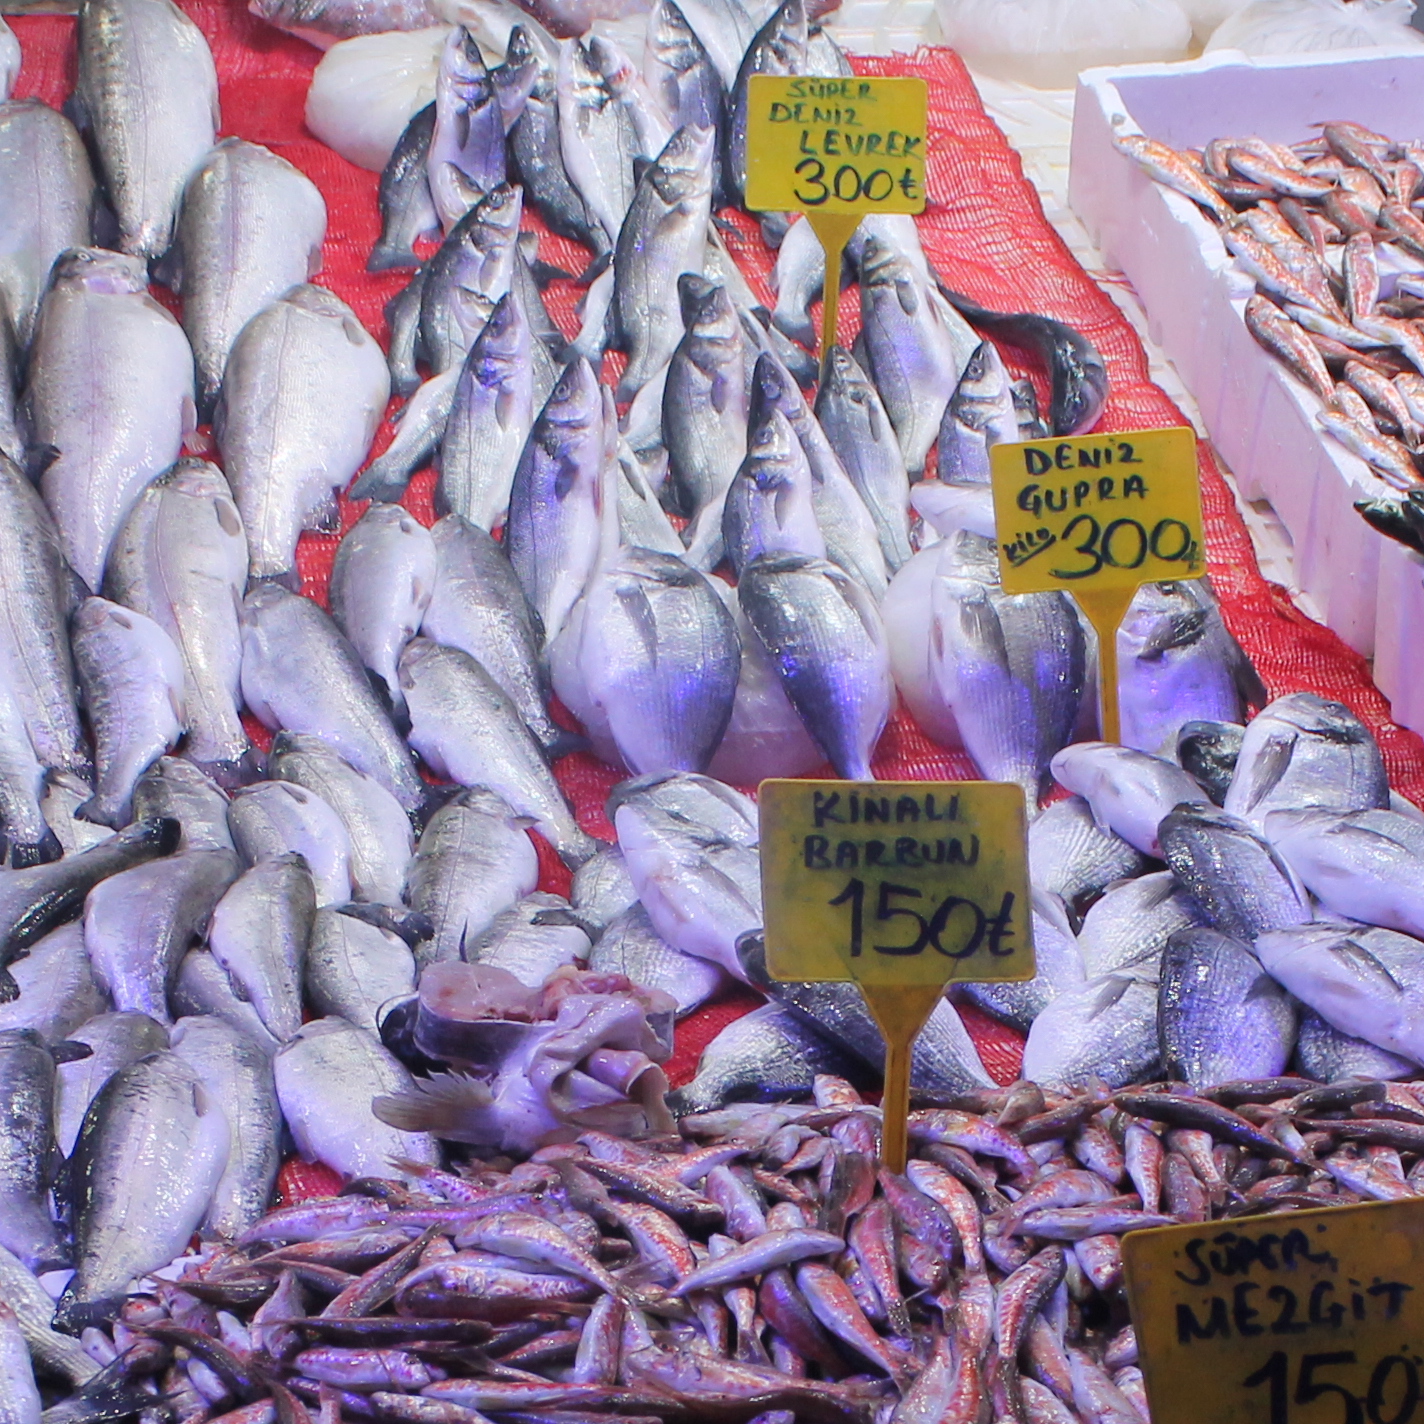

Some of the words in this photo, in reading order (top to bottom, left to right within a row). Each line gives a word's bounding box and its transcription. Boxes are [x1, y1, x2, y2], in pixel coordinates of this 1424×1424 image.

[787, 79, 877, 101] SÜPER
[799, 129, 922, 160] LEVREK
[1016, 473, 1149, 519] GUPRA
[803, 834, 981, 869] BARBUN
